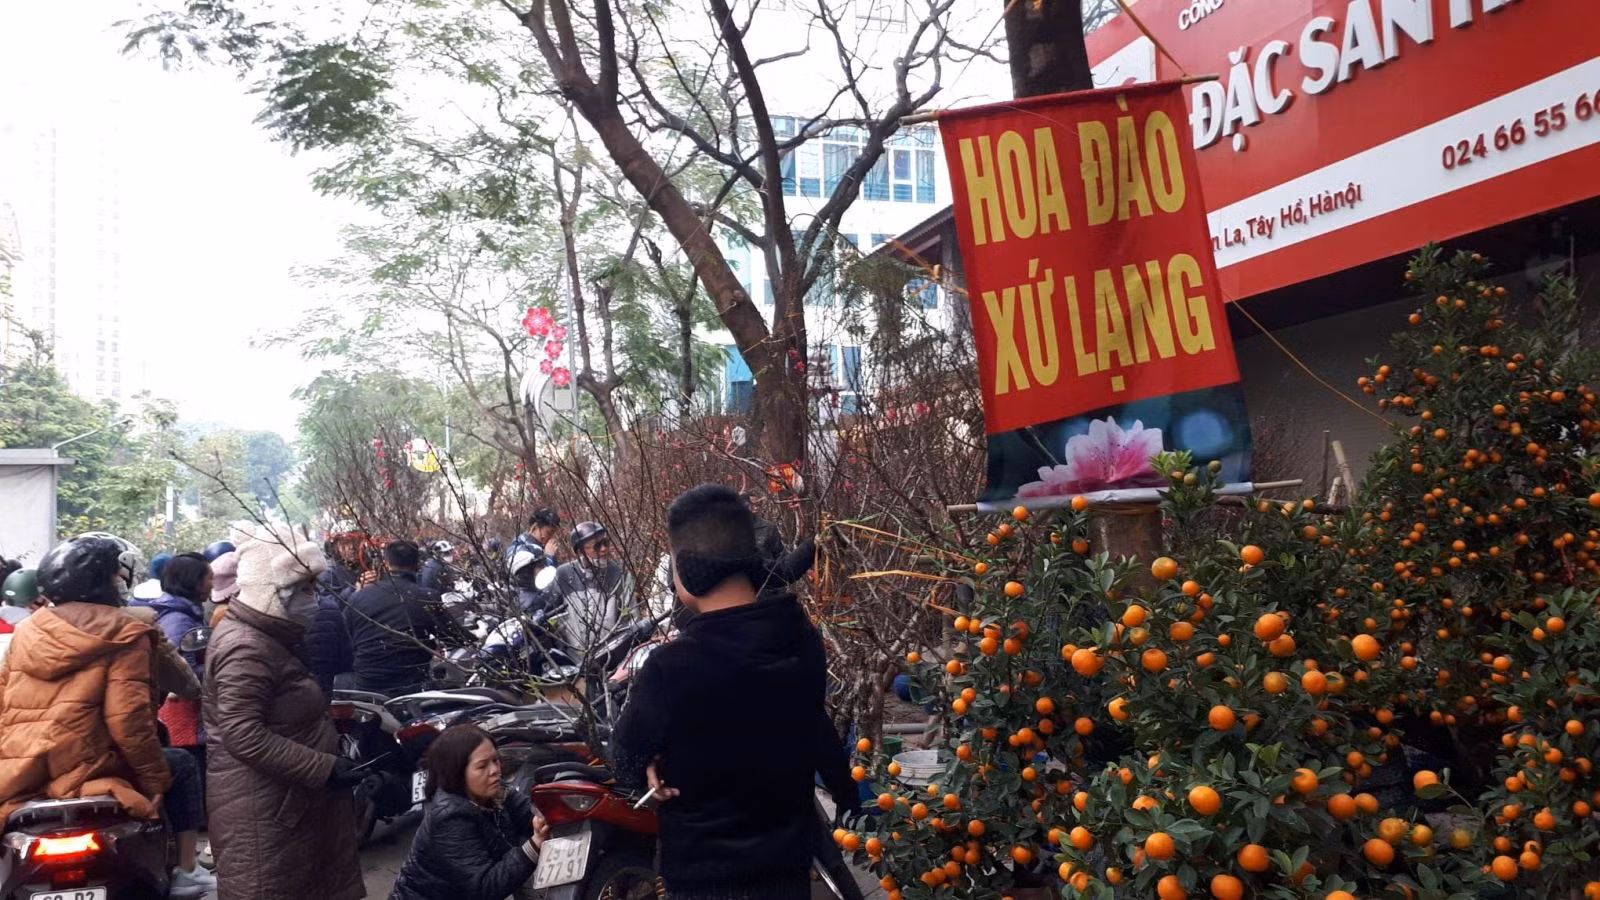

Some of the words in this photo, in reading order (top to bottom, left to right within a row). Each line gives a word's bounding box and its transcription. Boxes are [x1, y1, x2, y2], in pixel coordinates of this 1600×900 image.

[1188, 39, 1294, 152] ĐẶC
[1442, 133, 1488, 170] 024
[1494, 118, 1526, 151] 66
[1534, 102, 1567, 137] 55
[958, 127, 1072, 246] HOA
[1077, 94, 1186, 226] ĐÀO
[1224, 228, 1246, 247] La,
[1246, 215, 1275, 239] Tây
[1280, 198, 1308, 228] Hồ,
[981, 258, 1060, 396] XỨ
[1064, 253, 1216, 392] LẠNG
